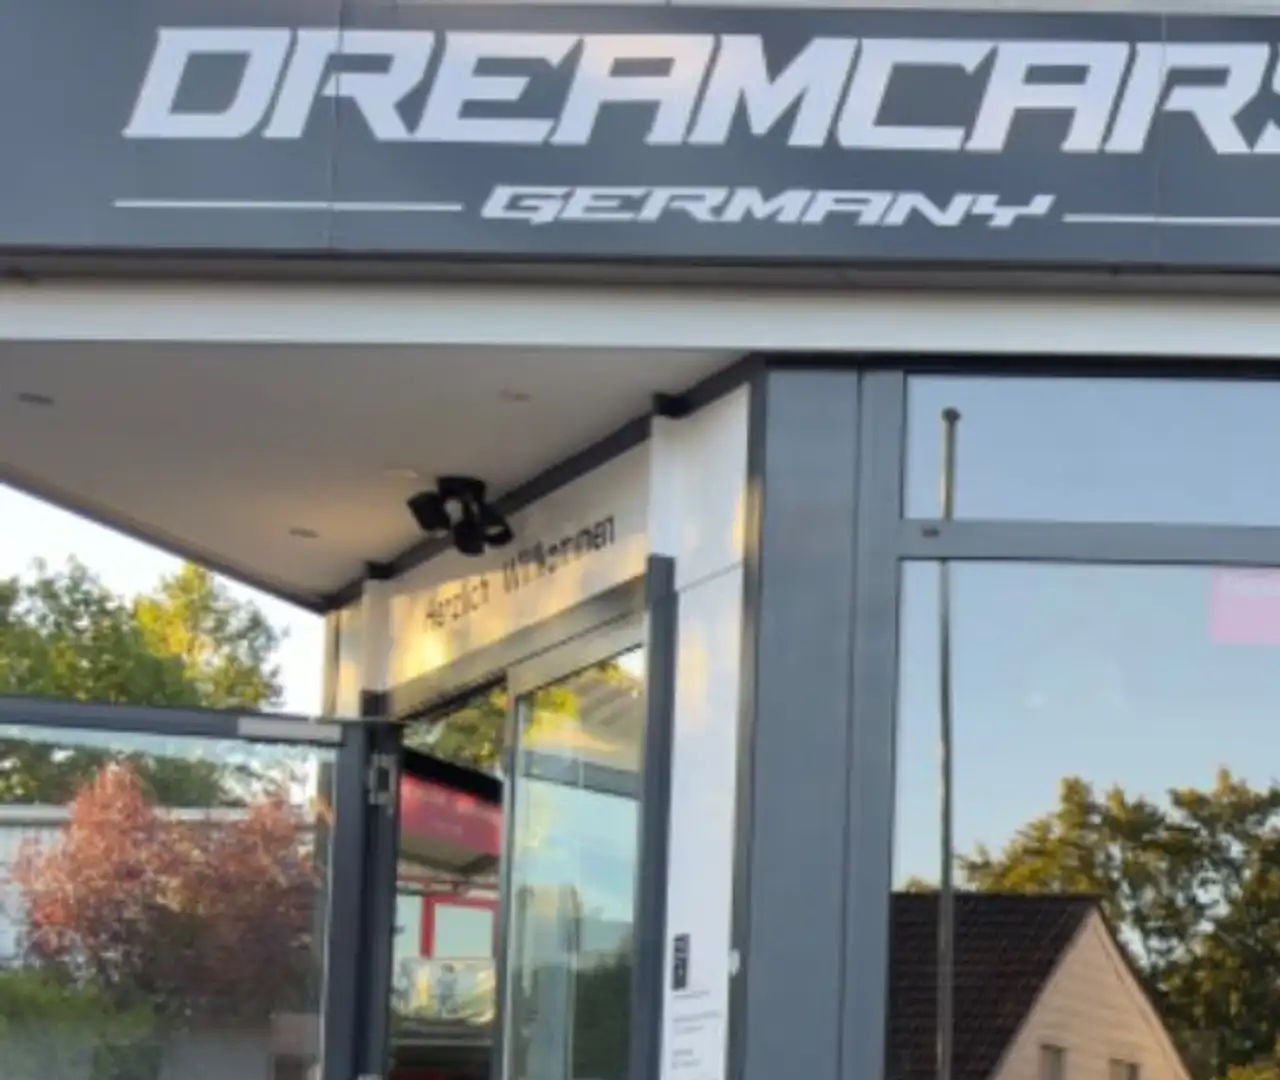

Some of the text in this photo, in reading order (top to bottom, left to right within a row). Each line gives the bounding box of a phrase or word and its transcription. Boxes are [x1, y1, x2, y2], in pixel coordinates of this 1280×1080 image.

[480, 185, 1056, 228] GERMANY
[424, 514, 615, 631] Herzlich Willkommen
